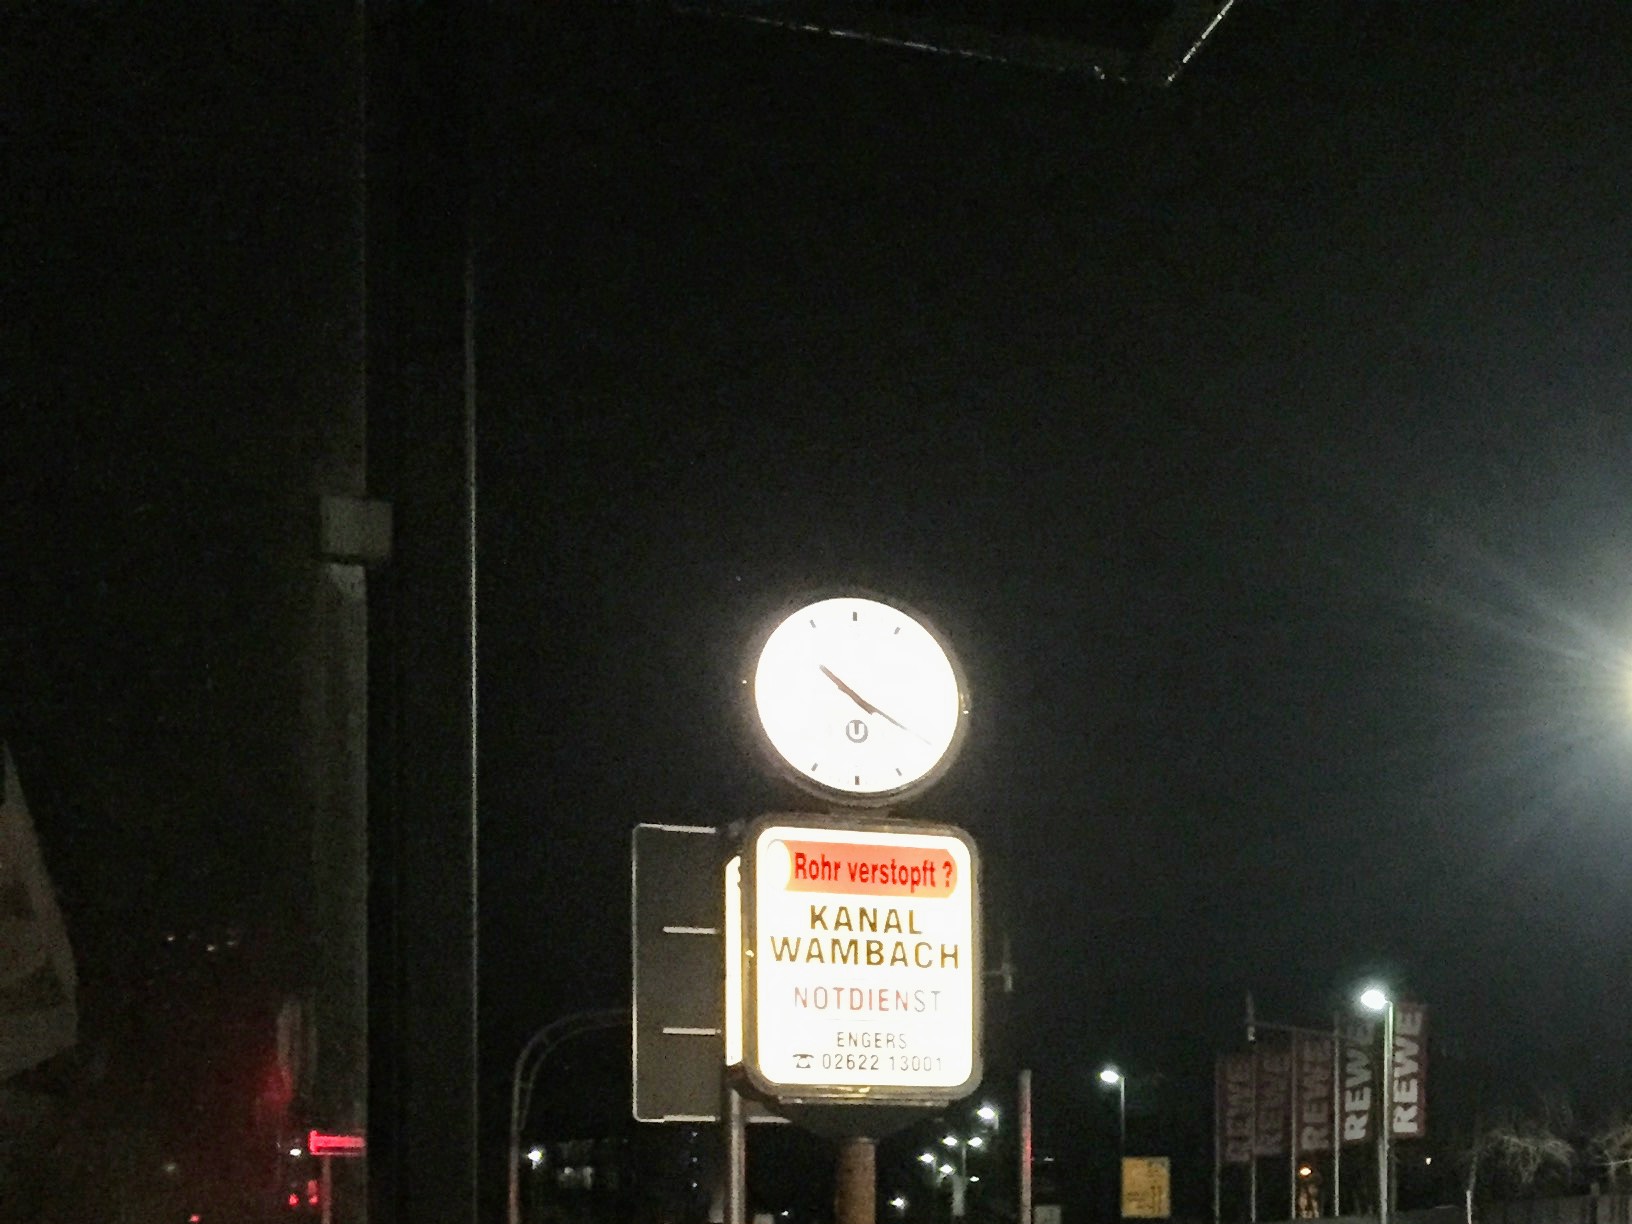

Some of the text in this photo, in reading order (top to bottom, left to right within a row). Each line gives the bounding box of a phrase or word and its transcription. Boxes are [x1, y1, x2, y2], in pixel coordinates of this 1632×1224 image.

[794, 852, 841, 881] Rohr
[848, 859, 936, 893] verstopft
[810, 905, 922, 935] KANAL
[770, 936, 959, 969] WAMBACH
[794, 986, 941, 1013] NOTDIENST
[836, 1031, 908, 1049] ENGERS
[822, 1054, 943, 1072] 02622 13001
[1392, 1010, 1424, 1134] REWE
